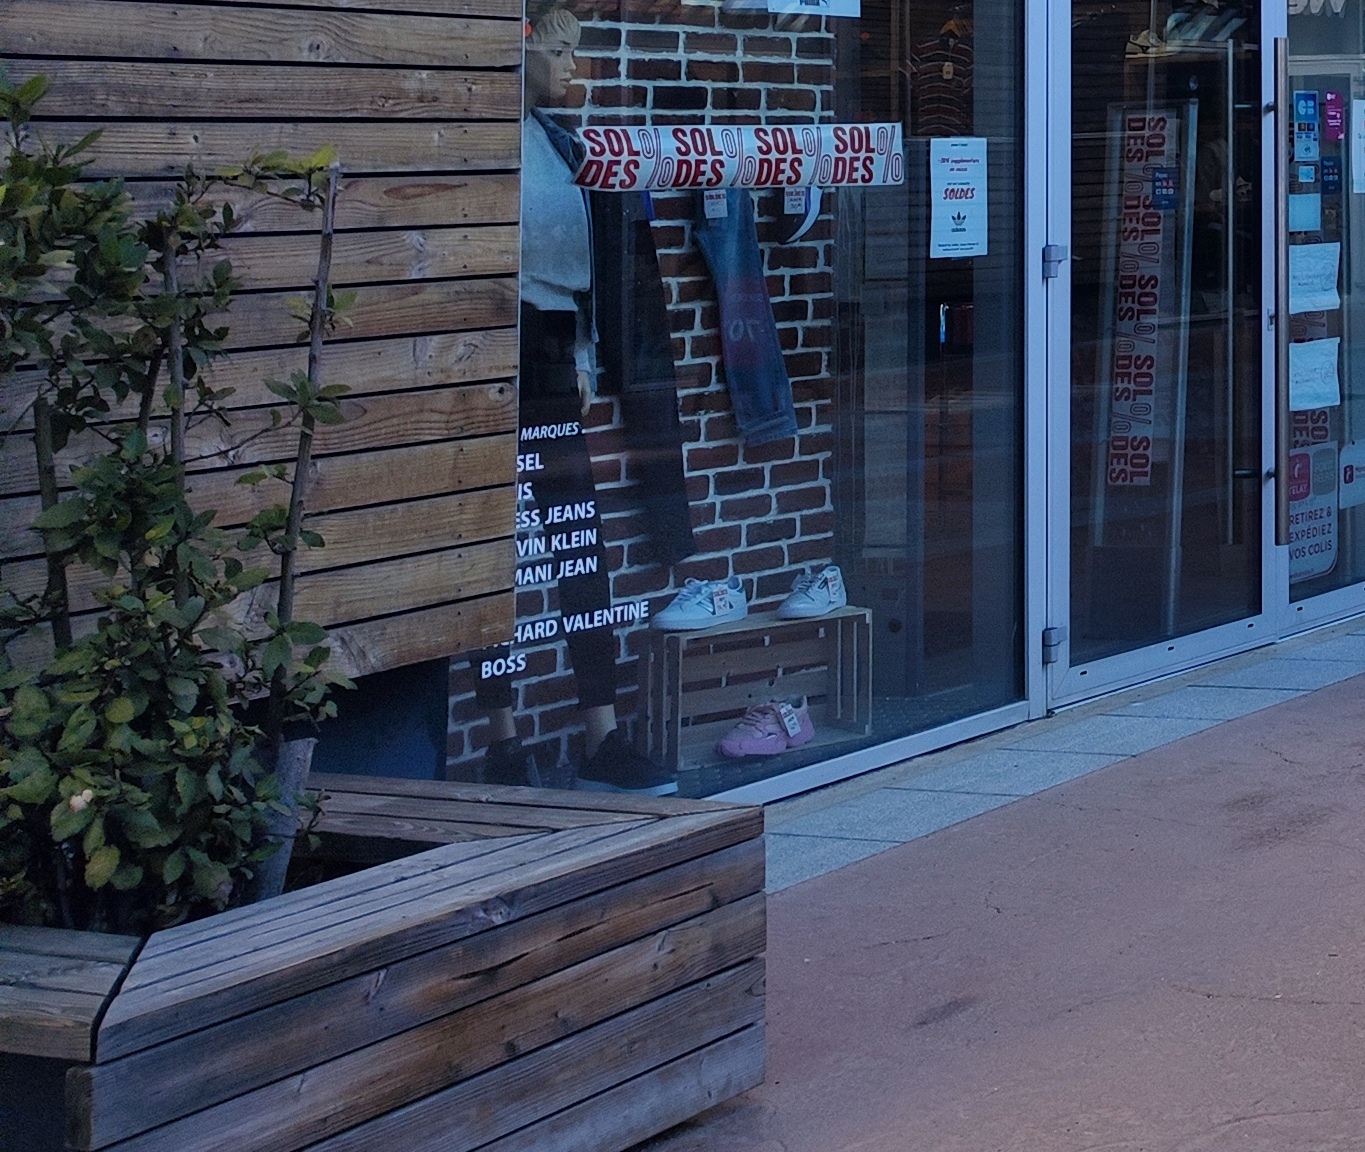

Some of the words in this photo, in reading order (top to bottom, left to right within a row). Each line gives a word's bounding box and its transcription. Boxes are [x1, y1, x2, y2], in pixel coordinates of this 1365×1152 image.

[583, 128, 641, 157] SOL
[671, 127, 724, 157] SOL
[754, 127, 804, 155] SOL
[833, 126, 876, 154] SOL
[1126, 117, 1147, 163] DES
[574, 158, 640, 189] DES
[671, 158, 725, 188] DES
[754, 157, 804, 186] DES
[831, 156, 874, 184] DES
[943, 188, 975, 200] SOLDES
[1122, 195, 1141, 241] DES
[1118, 274, 1137, 321] DES
[1136, 274, 1159, 321] SOL
[1114, 354, 1133, 402] DES
[1132, 354, 1155, 402] SOL
[520, 422, 580, 441] MARQUES
[1310, 410, 1329, 444] SO
[1108, 435, 1129, 483] DES
[1129, 435, 1151, 483] SOL
[545, 501, 596, 526] JEANS
[1289, 507, 1325, 525] RETIREZ
[1326, 506, 1332, 517] &
[551, 528, 597, 552] KLEIN
[1289, 523, 1332, 543] EXPÉDIEZ
[1289, 546, 1307, 560] VOS
[1308, 540, 1333, 556] COLIS
[556, 556, 598, 581] JEAN
[562, 600, 650, 633] VALENTINE
[481, 653, 527, 680] BOSS
